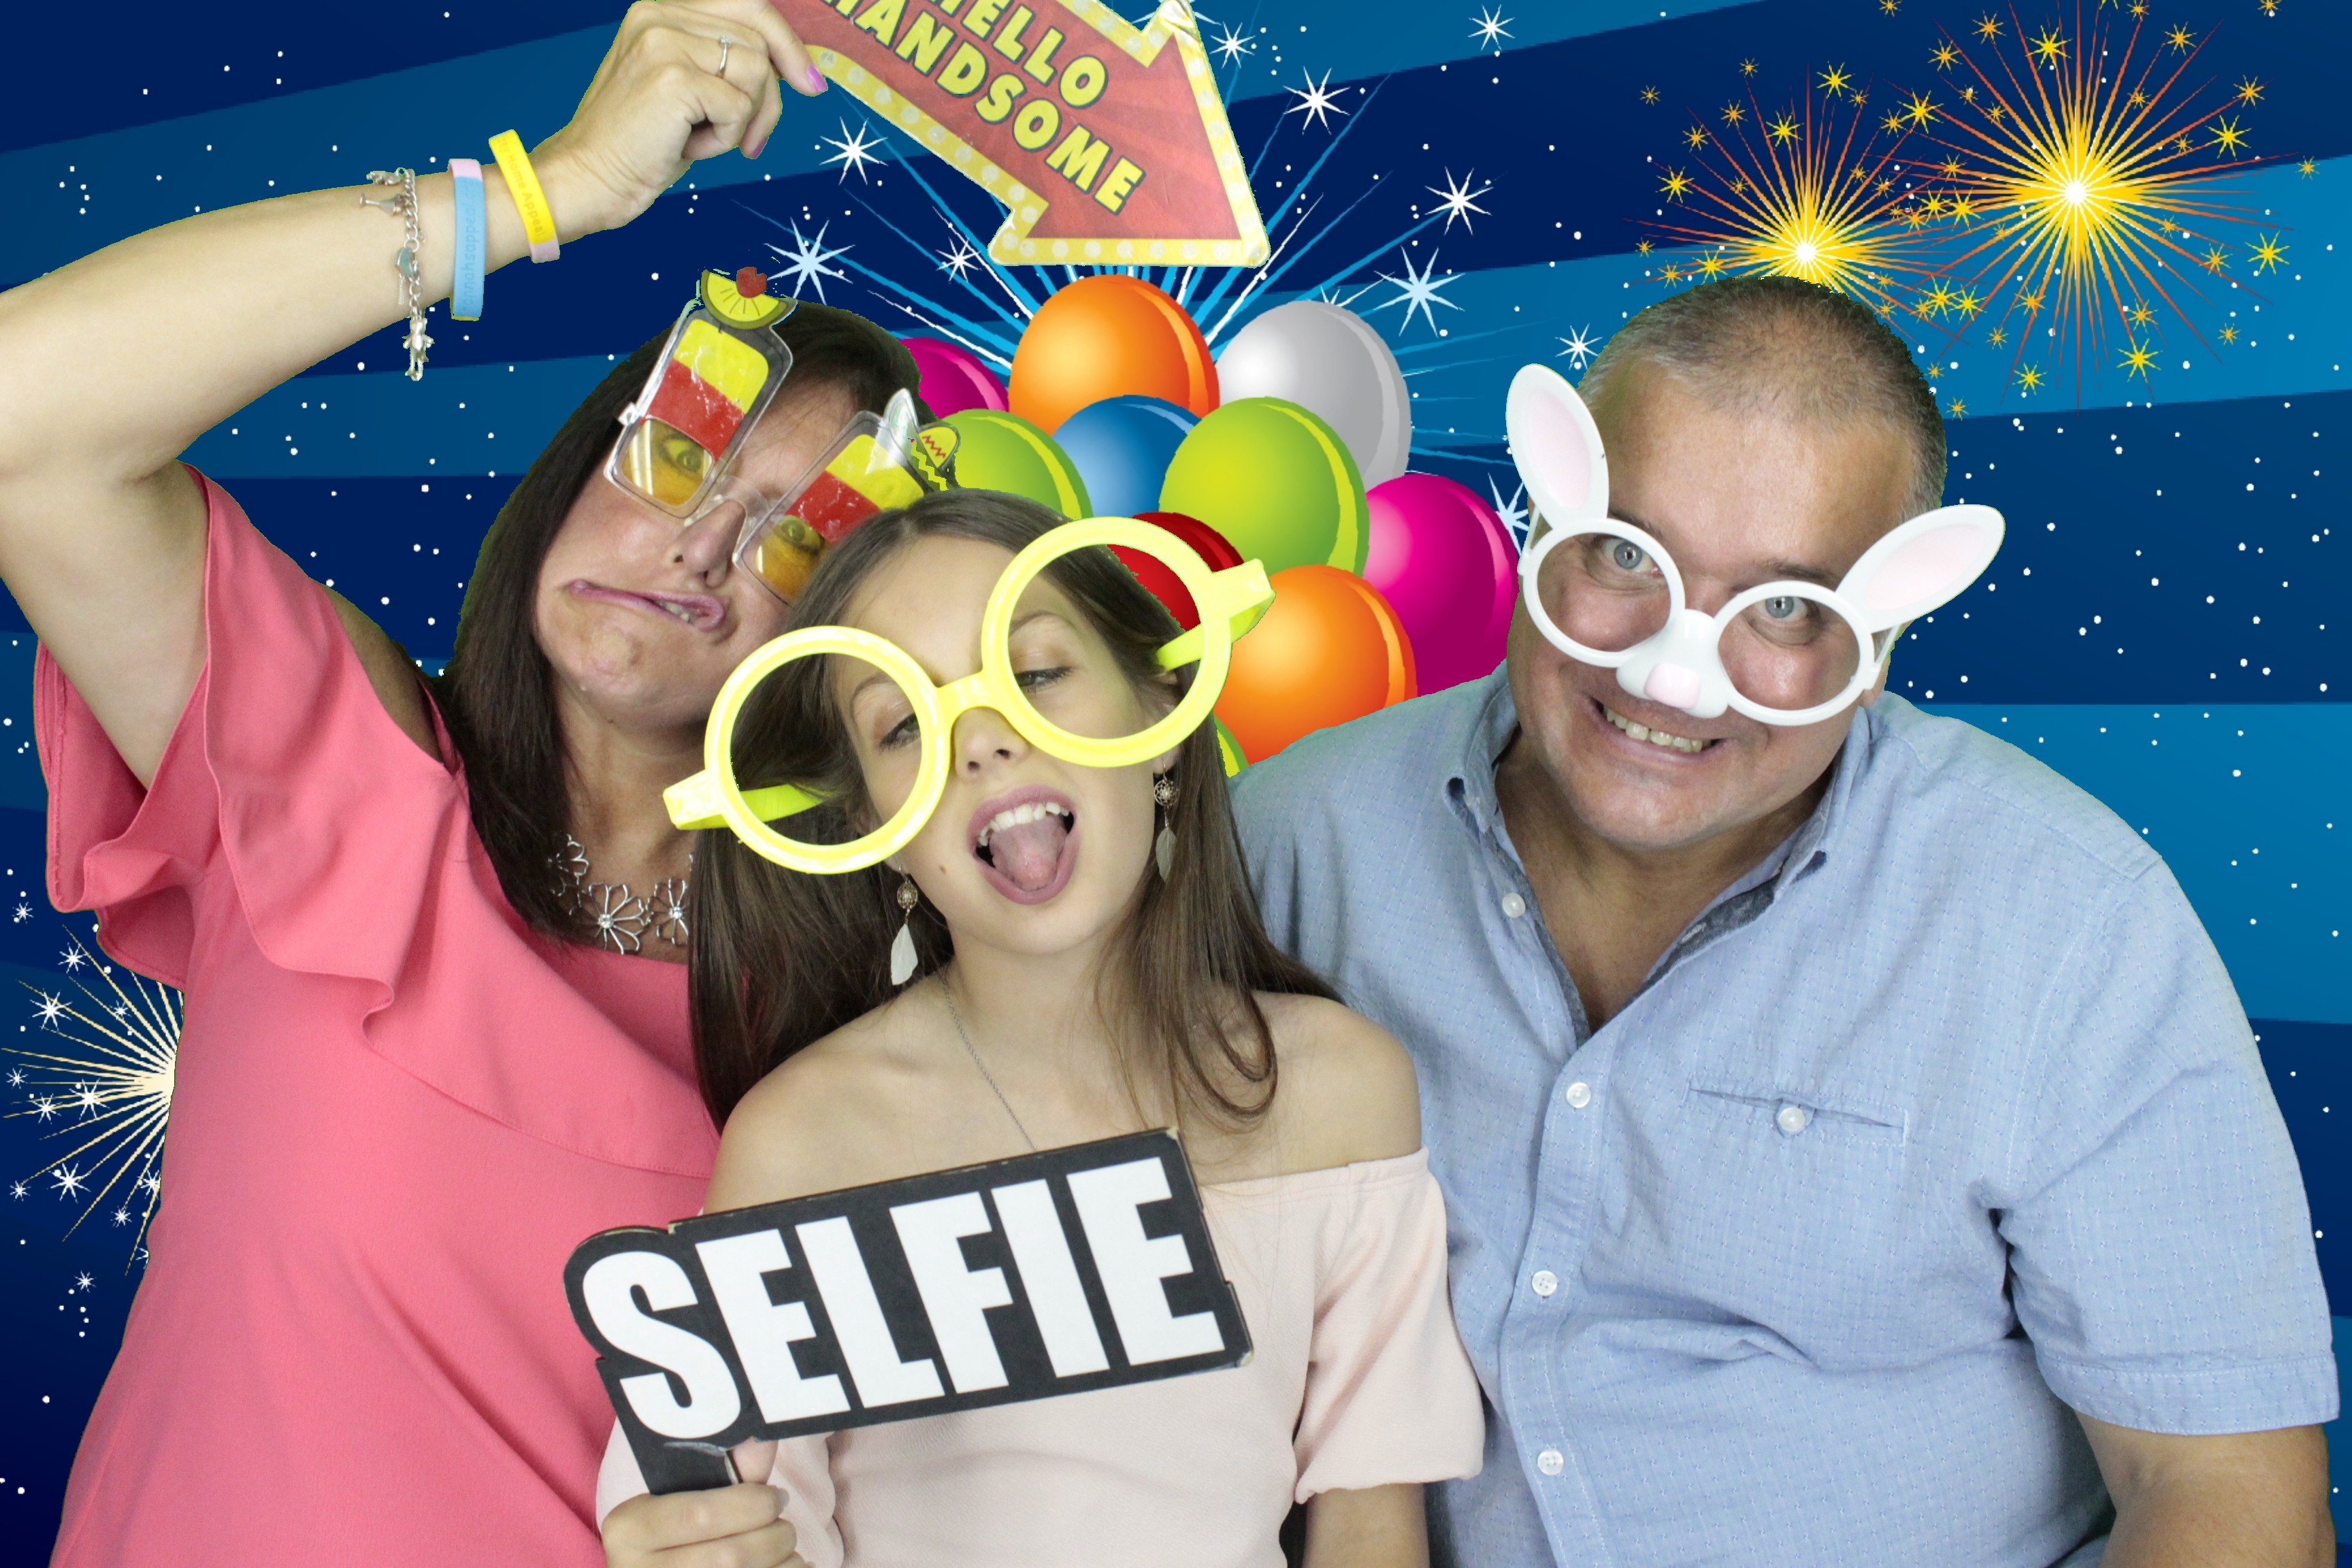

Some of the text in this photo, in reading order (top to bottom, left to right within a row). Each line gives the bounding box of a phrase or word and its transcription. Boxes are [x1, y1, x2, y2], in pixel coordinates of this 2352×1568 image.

[926, 0, 1109, 108] ELLO
[505, 153, 526, 189] Home
[521, 192, 545, 236] Appeal
[582, 1157, 1226, 1439] SELFIE
